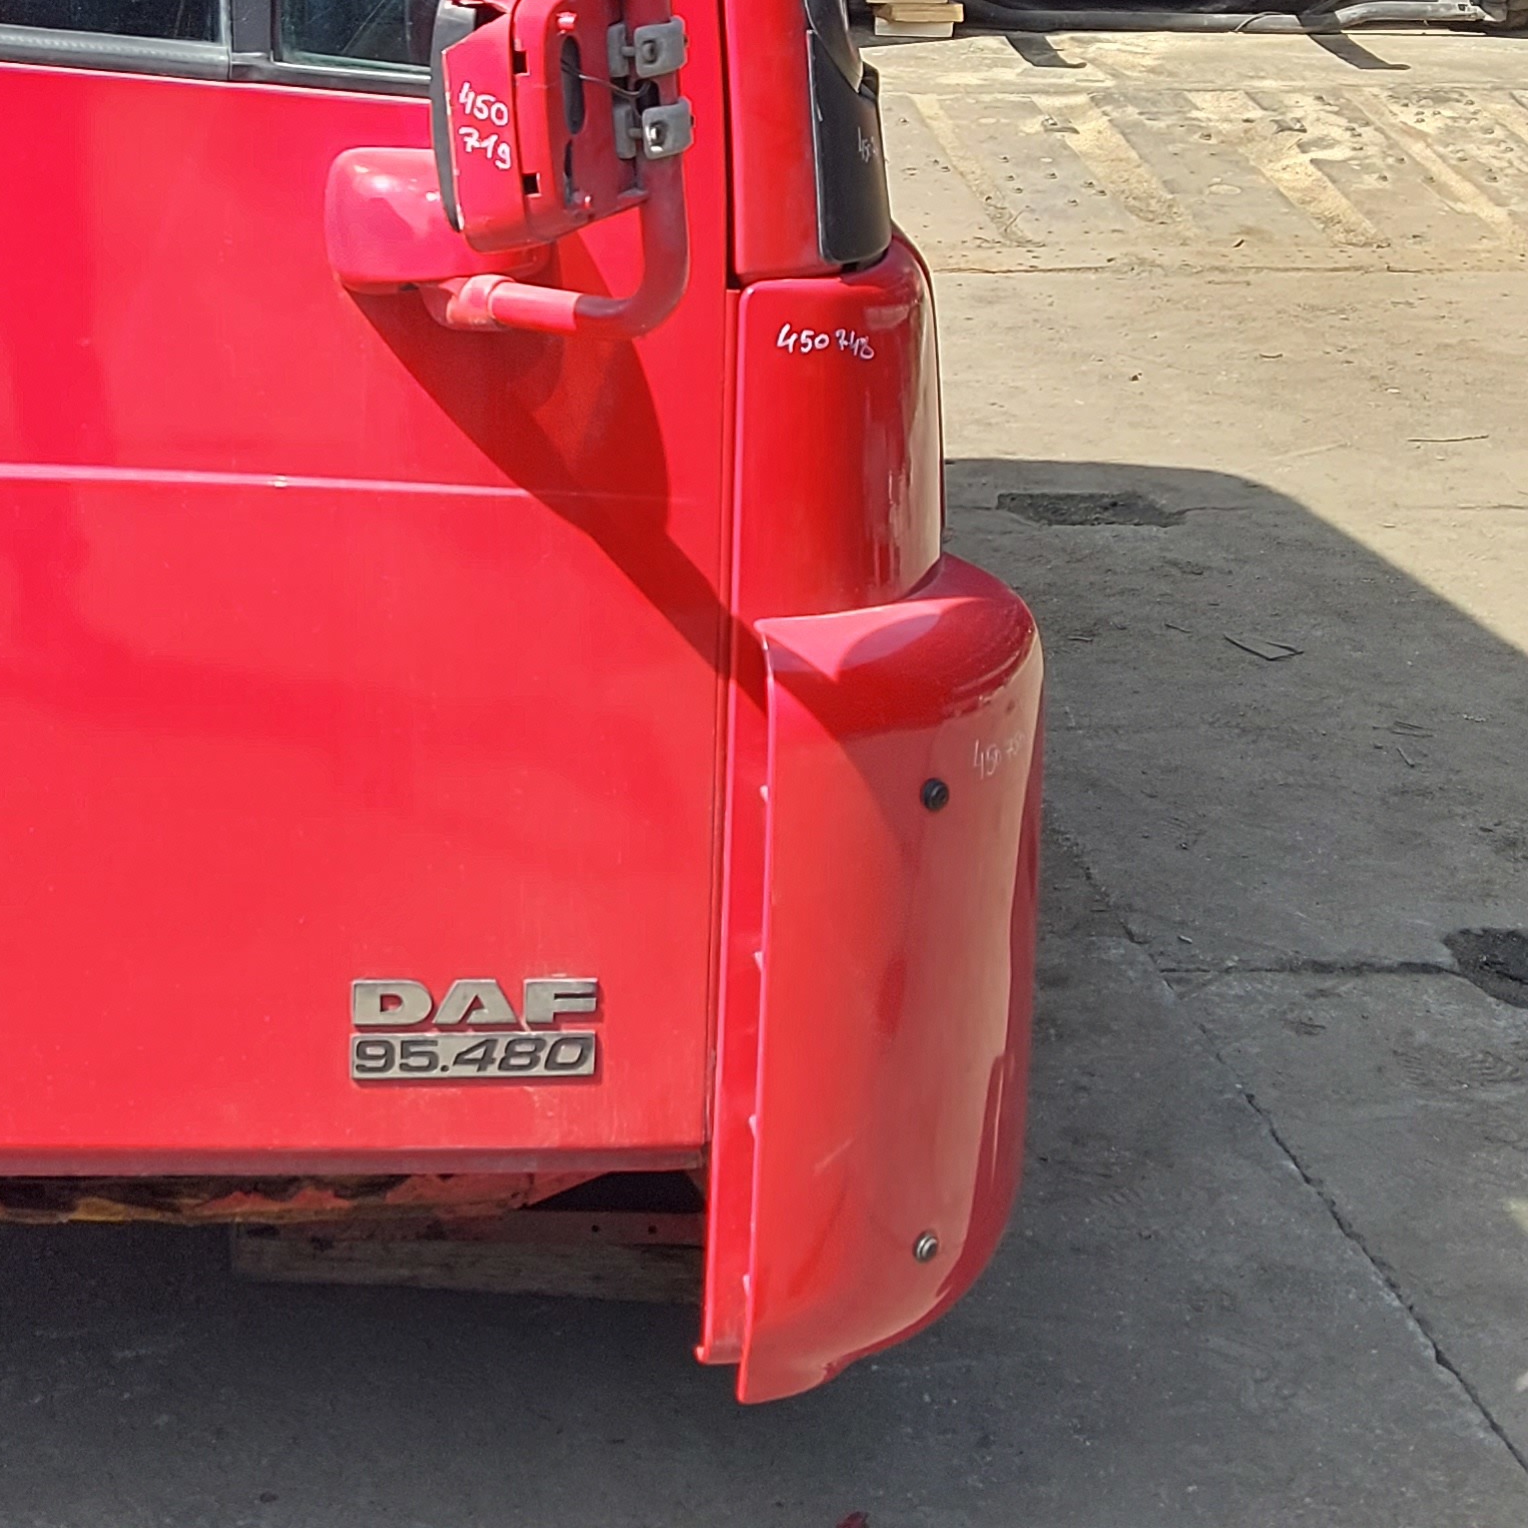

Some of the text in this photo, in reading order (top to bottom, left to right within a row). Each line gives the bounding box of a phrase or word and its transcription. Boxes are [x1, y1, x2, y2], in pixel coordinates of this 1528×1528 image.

[458, 81, 509, 127] 450
[458, 126, 512, 170] 719
[776, 322, 830, 354] 450
[350, 977, 599, 1026] DAF
[354, 1036, 594, 1074] 95.480
